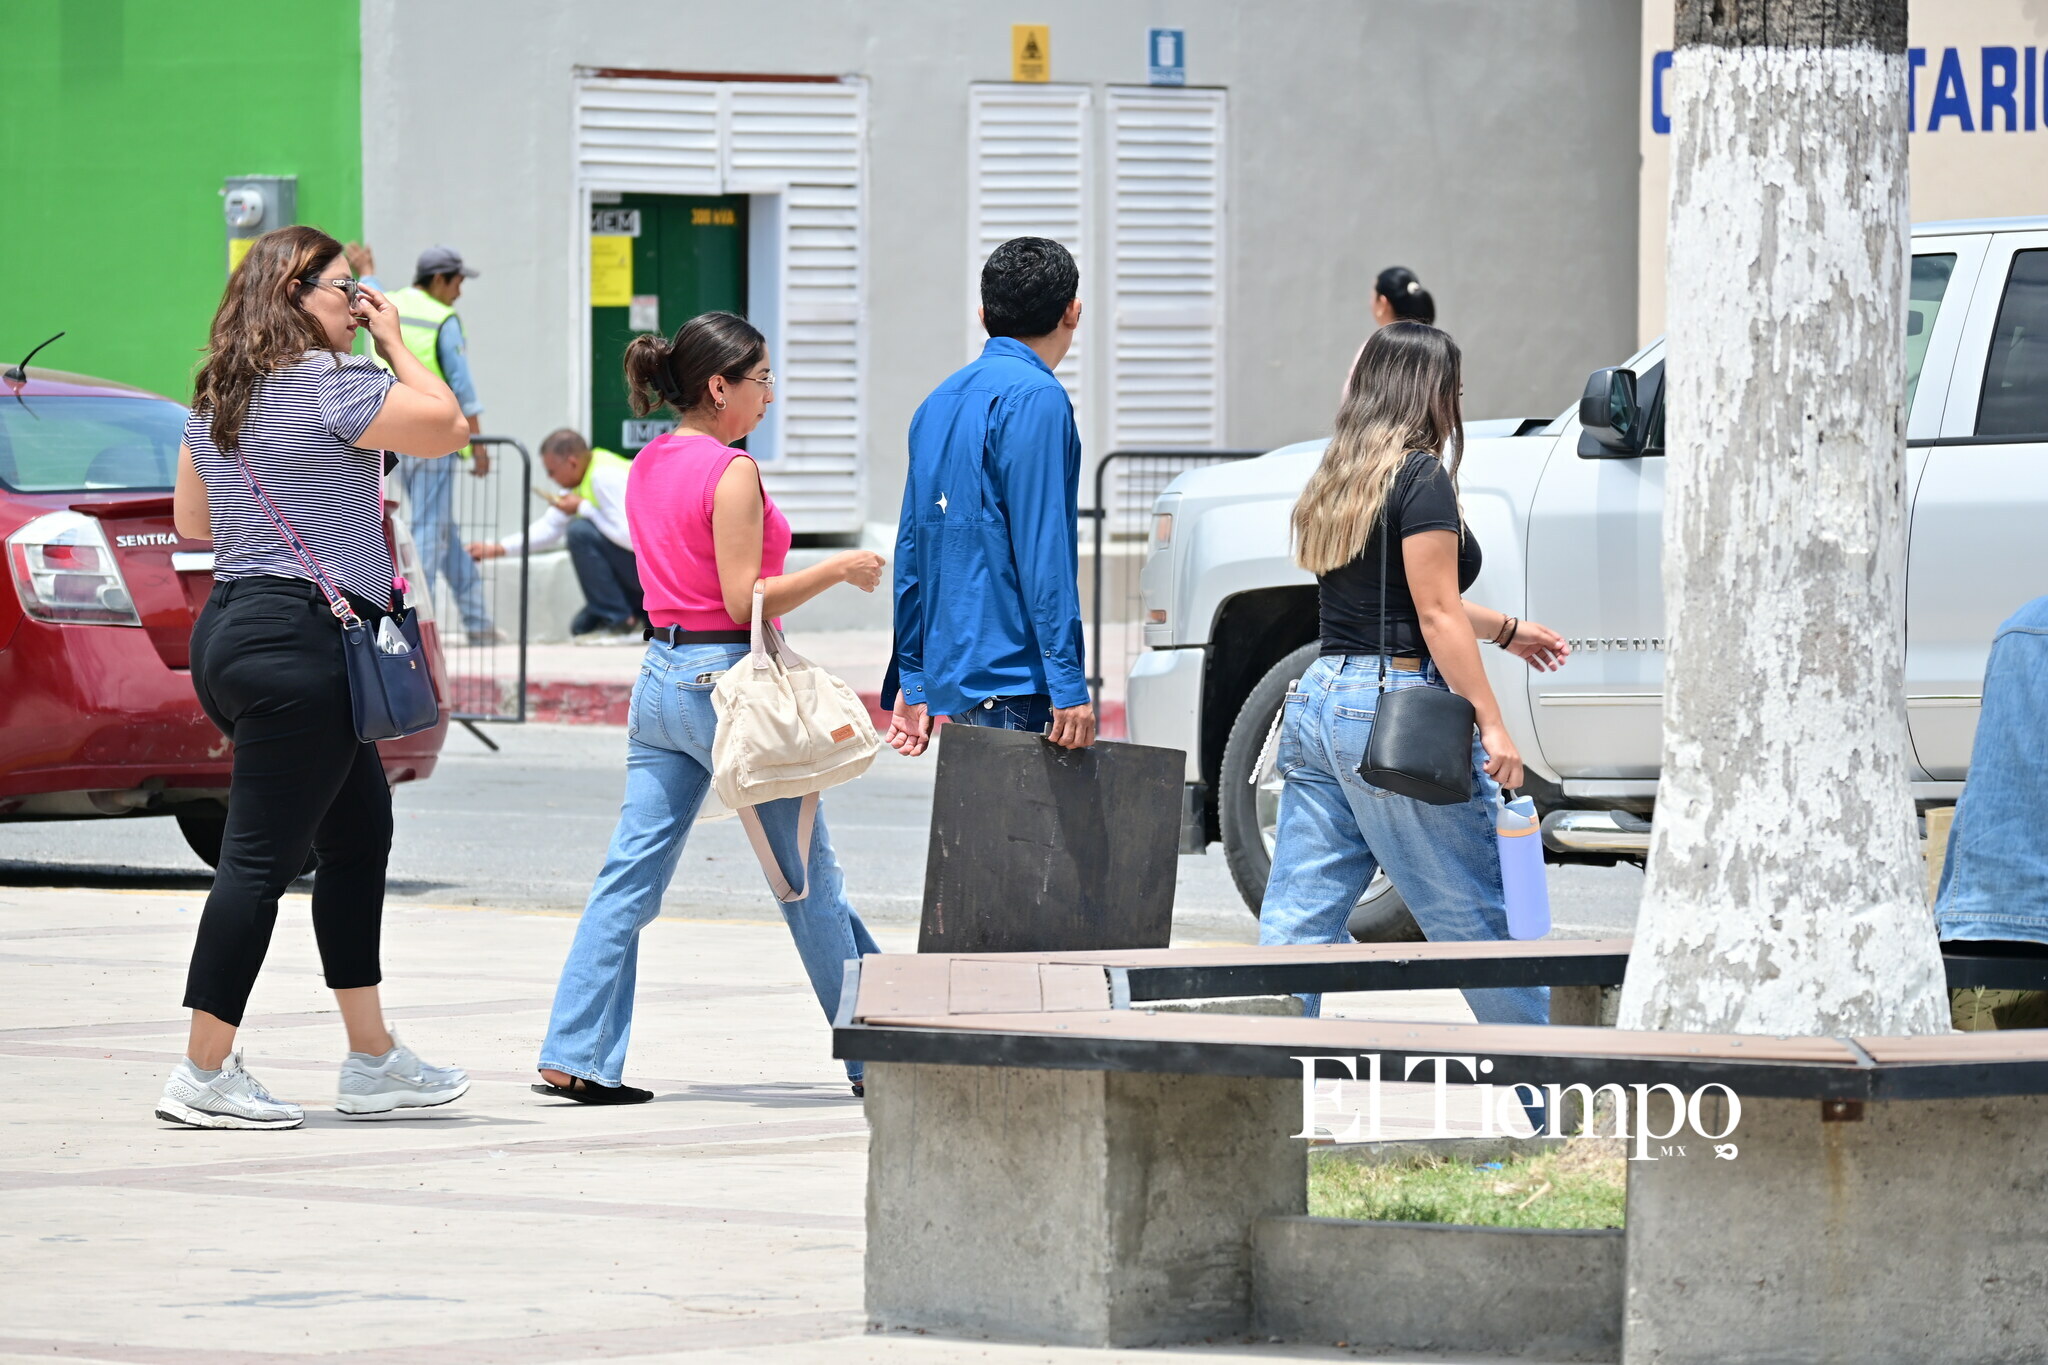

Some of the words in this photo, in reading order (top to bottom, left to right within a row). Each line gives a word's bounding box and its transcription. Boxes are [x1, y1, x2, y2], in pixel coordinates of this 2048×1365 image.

[591, 211, 636, 233] MEM
[257, 492, 279, 521] HILFIGER
[116, 532, 179, 548] SENTRA
[278, 521, 296, 544] TOMMY
[298, 548, 320, 576] HILFIGER
[319, 577, 336, 600] TOMMY
[1568, 637, 1665, 652] HEYENN
